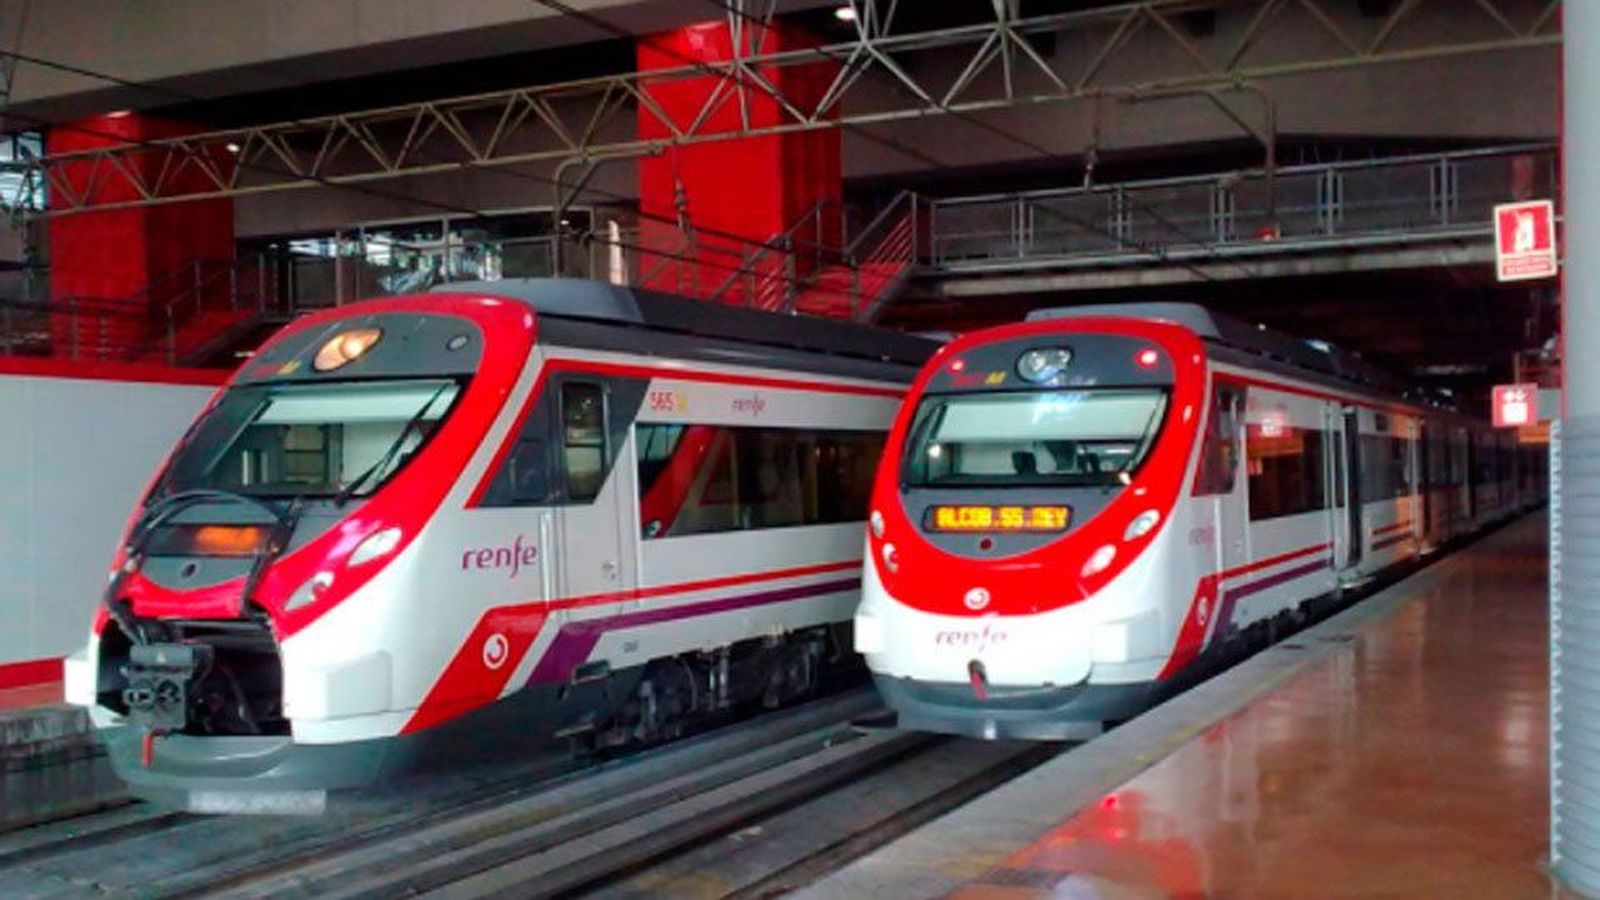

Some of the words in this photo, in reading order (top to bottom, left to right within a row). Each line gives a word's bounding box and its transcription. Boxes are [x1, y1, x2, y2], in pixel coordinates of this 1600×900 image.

[731, 393, 766, 416] renfe
[462, 533, 538, 579] renfe
[935, 622, 1009, 654] renfe
